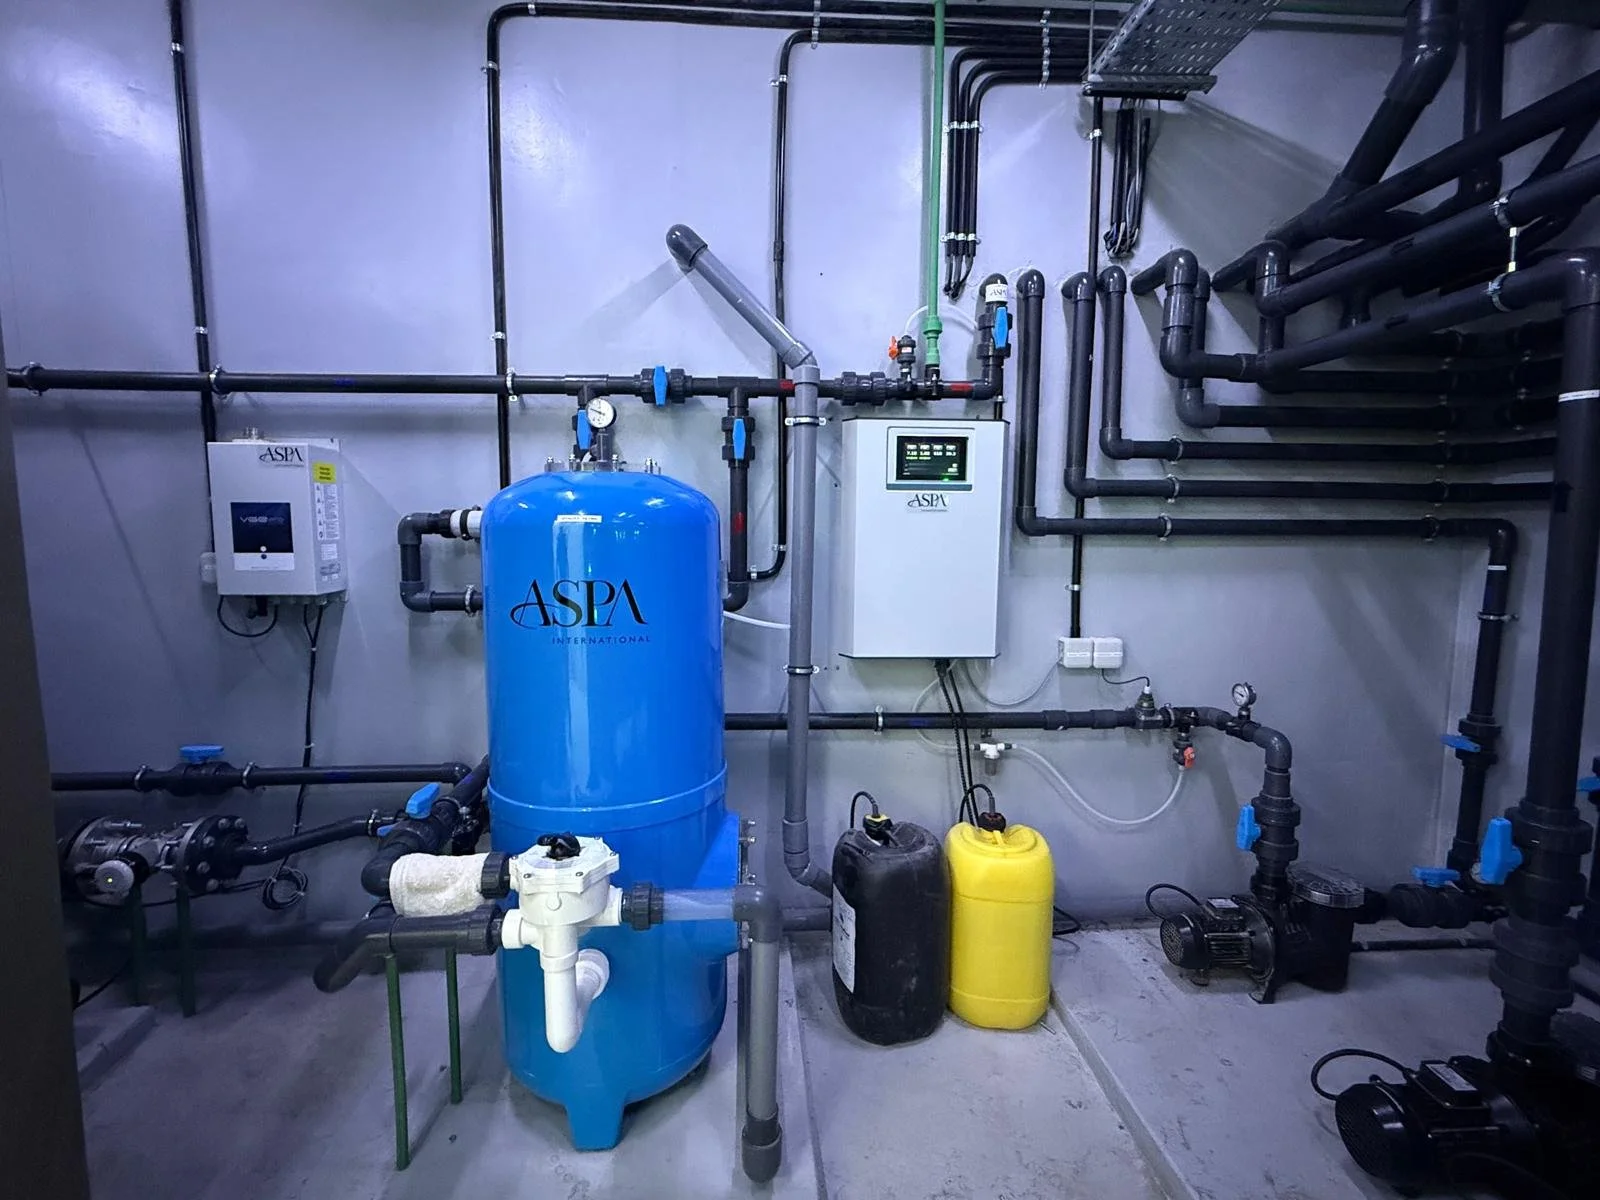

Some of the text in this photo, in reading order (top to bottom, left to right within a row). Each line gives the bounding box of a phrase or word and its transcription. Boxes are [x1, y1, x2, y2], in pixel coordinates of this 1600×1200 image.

[259, 447, 303, 463] ASPA
[907, 493, 947, 508] ASPA
[510, 578, 648, 629] ASPA
[552, 635, 651, 645] INTERNATIONAL
